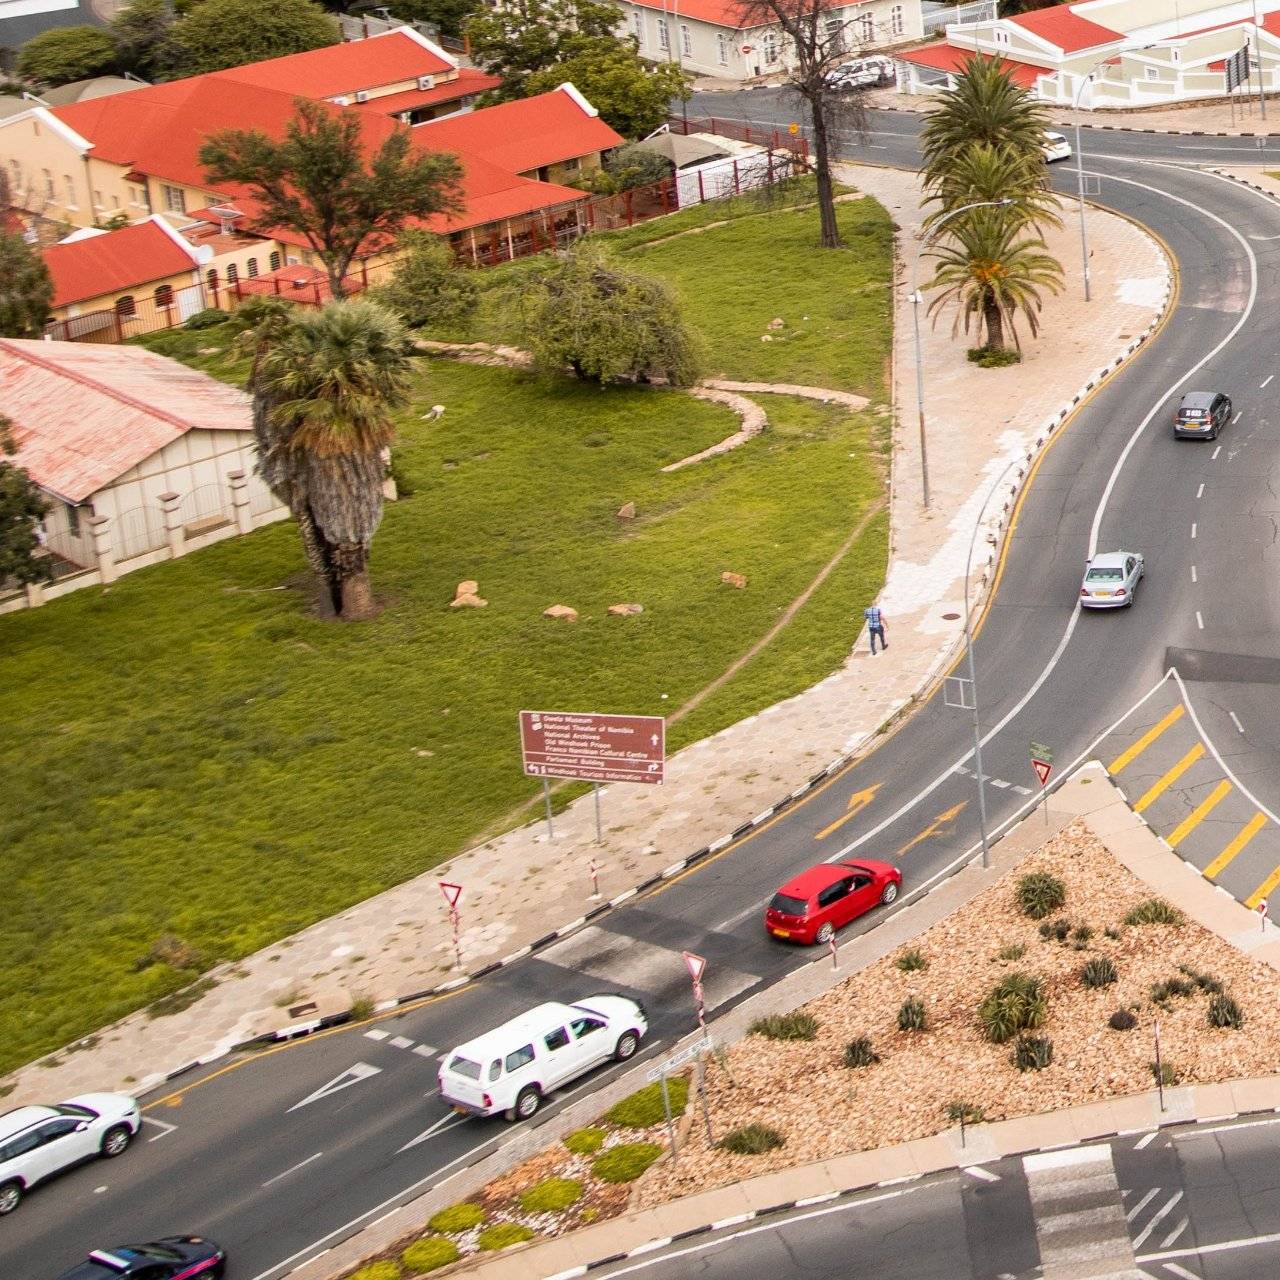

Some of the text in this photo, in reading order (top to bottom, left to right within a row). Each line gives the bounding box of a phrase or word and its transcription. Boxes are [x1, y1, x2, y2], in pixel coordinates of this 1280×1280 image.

[543, 723, 571, 731] National
[544, 731, 601, 740] National Archives
[544, 738, 557, 746] Old
[557, 740, 589, 748] Windhoek
[599, 749, 625, 758] Cultural
[546, 756, 605, 768] Parliament Building
[547, 768, 577, 777] Windhoek
